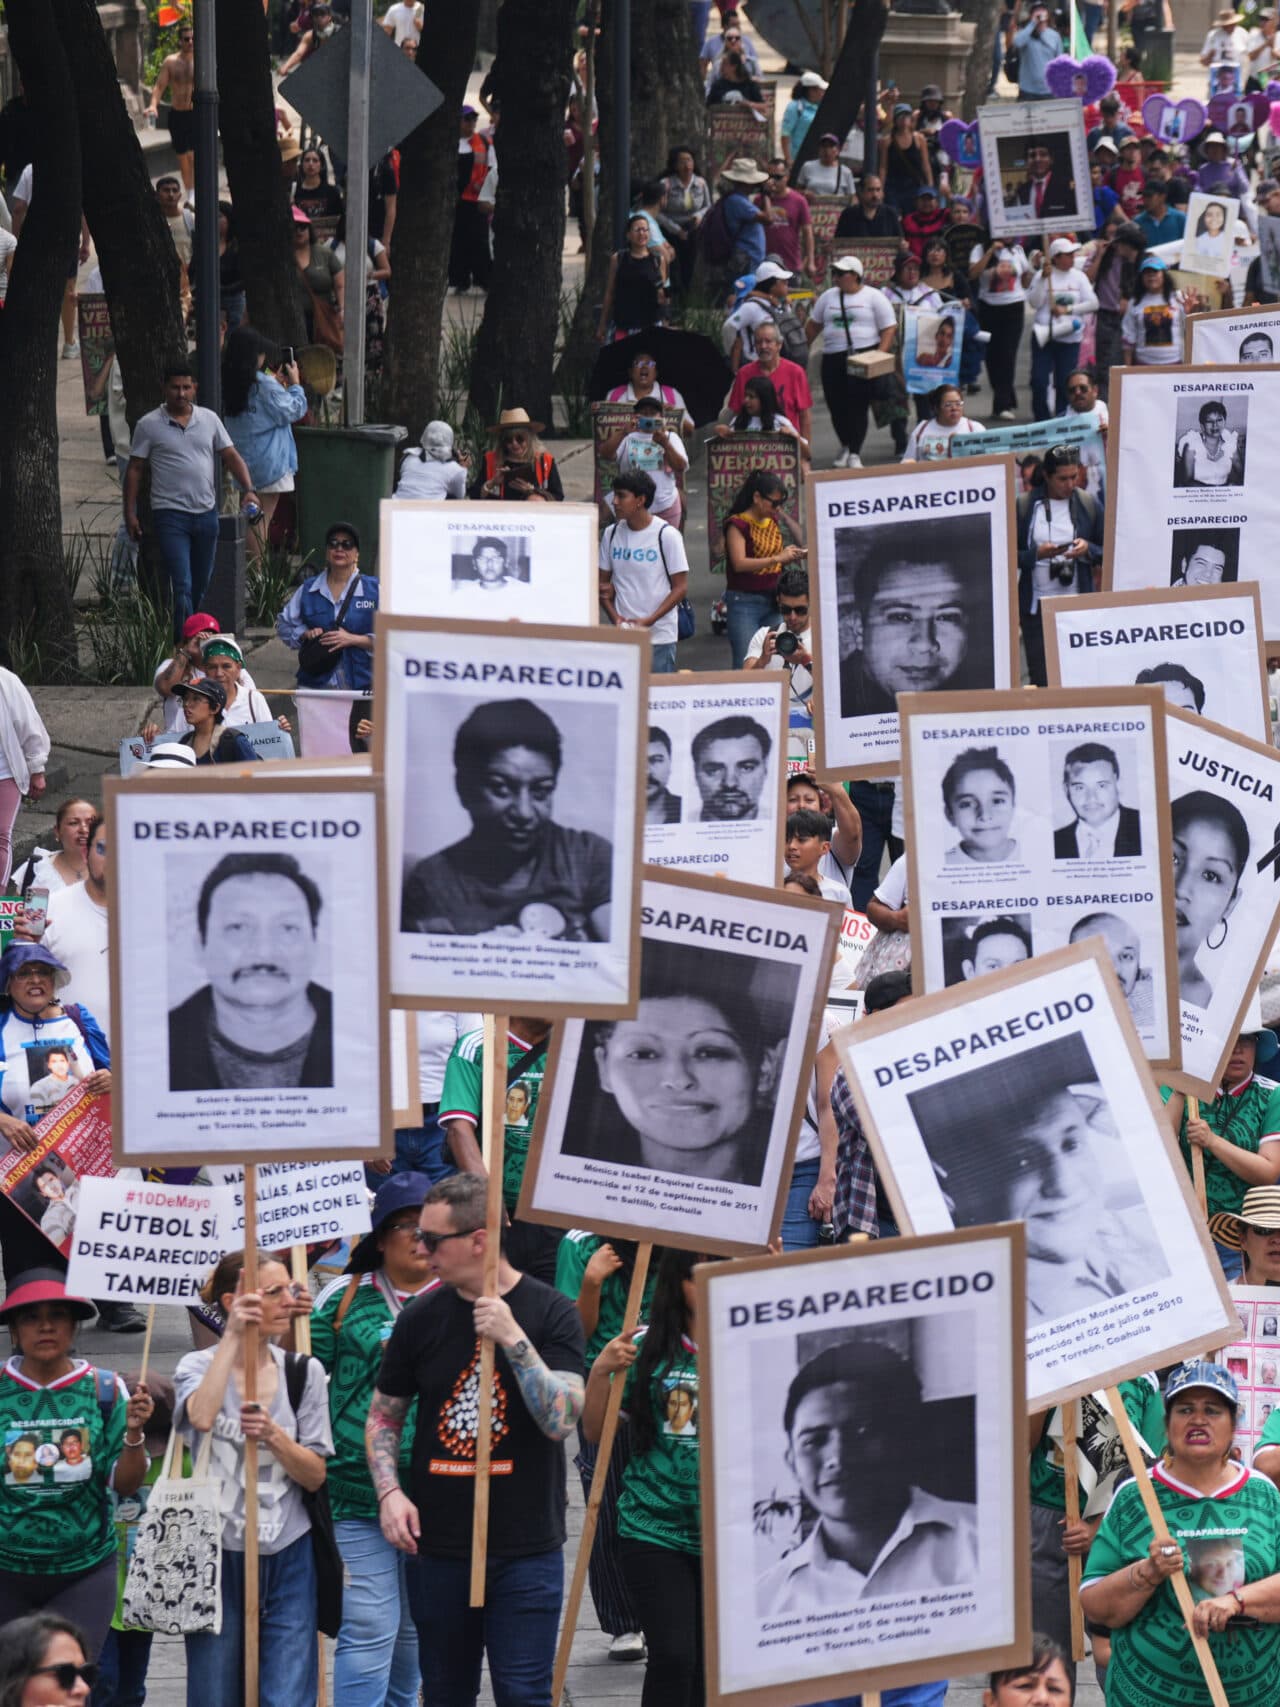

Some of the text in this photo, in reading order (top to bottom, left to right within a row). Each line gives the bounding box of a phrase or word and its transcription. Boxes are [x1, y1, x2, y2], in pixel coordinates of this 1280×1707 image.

[1173, 383, 1254, 392] DESAPARECIDA
[710, 454, 796, 470] VERDAD
[828, 487, 996, 517] DESAPARECIDO
[447, 523, 536, 532] DESAPARECIDO
[1167, 515, 1248, 525] DESAPARECIDO
[612, 547, 658, 562] HUGO
[1069, 619, 1245, 648] DESAPARECIDO
[404, 658, 623, 690] DESAPARECIDA
[693, 696, 775, 709] DESAPARECIDO
[922, 721, 1145, 741] DESAPARECIDO DESAPARECIDO
[1179, 750, 1275, 802] JUSTICIA
[134, 819, 361, 840] DESAPARECIDO
[648, 853, 729, 866] DESAPARECIDO
[932, 892, 1154, 912] DESAPARECIDO DESAPARECIDO
[641, 906, 810, 953] SAPARECIDA
[874, 993, 1094, 1087] DESAPARECIDO
[296, 1173, 317, 1192] ASÍ
[321, 1169, 362, 1188] COMO
[621, 1169, 651, 1181] Isabel
[654, 1175, 694, 1190] Esquivel
[697, 1183, 733, 1195] Castillo
[125, 1191, 211, 1211] #10DeMayo
[554, 1171, 758, 1213] desaparecida septiembre 2011
[313, 1193, 361, 1214] CON EL
[660, 1202, 702, 1216] Coahuila
[99, 1208, 193, 1238] FÚTBOL
[77, 1240, 227, 1266] DESAPARECIDOS
[104, 1271, 203, 1297] TAMBIÉN
[730, 1271, 995, 1328] DESAPARECIDO
[1050, 1290, 1159, 1336] Alberto Morales Cano
[1087, 1296, 1183, 1337] 02 de julio de 2010
[1106, 1325, 1151, 1346] Coahuila
[1177, 1528, 1248, 1537] DESAPARECIDO
